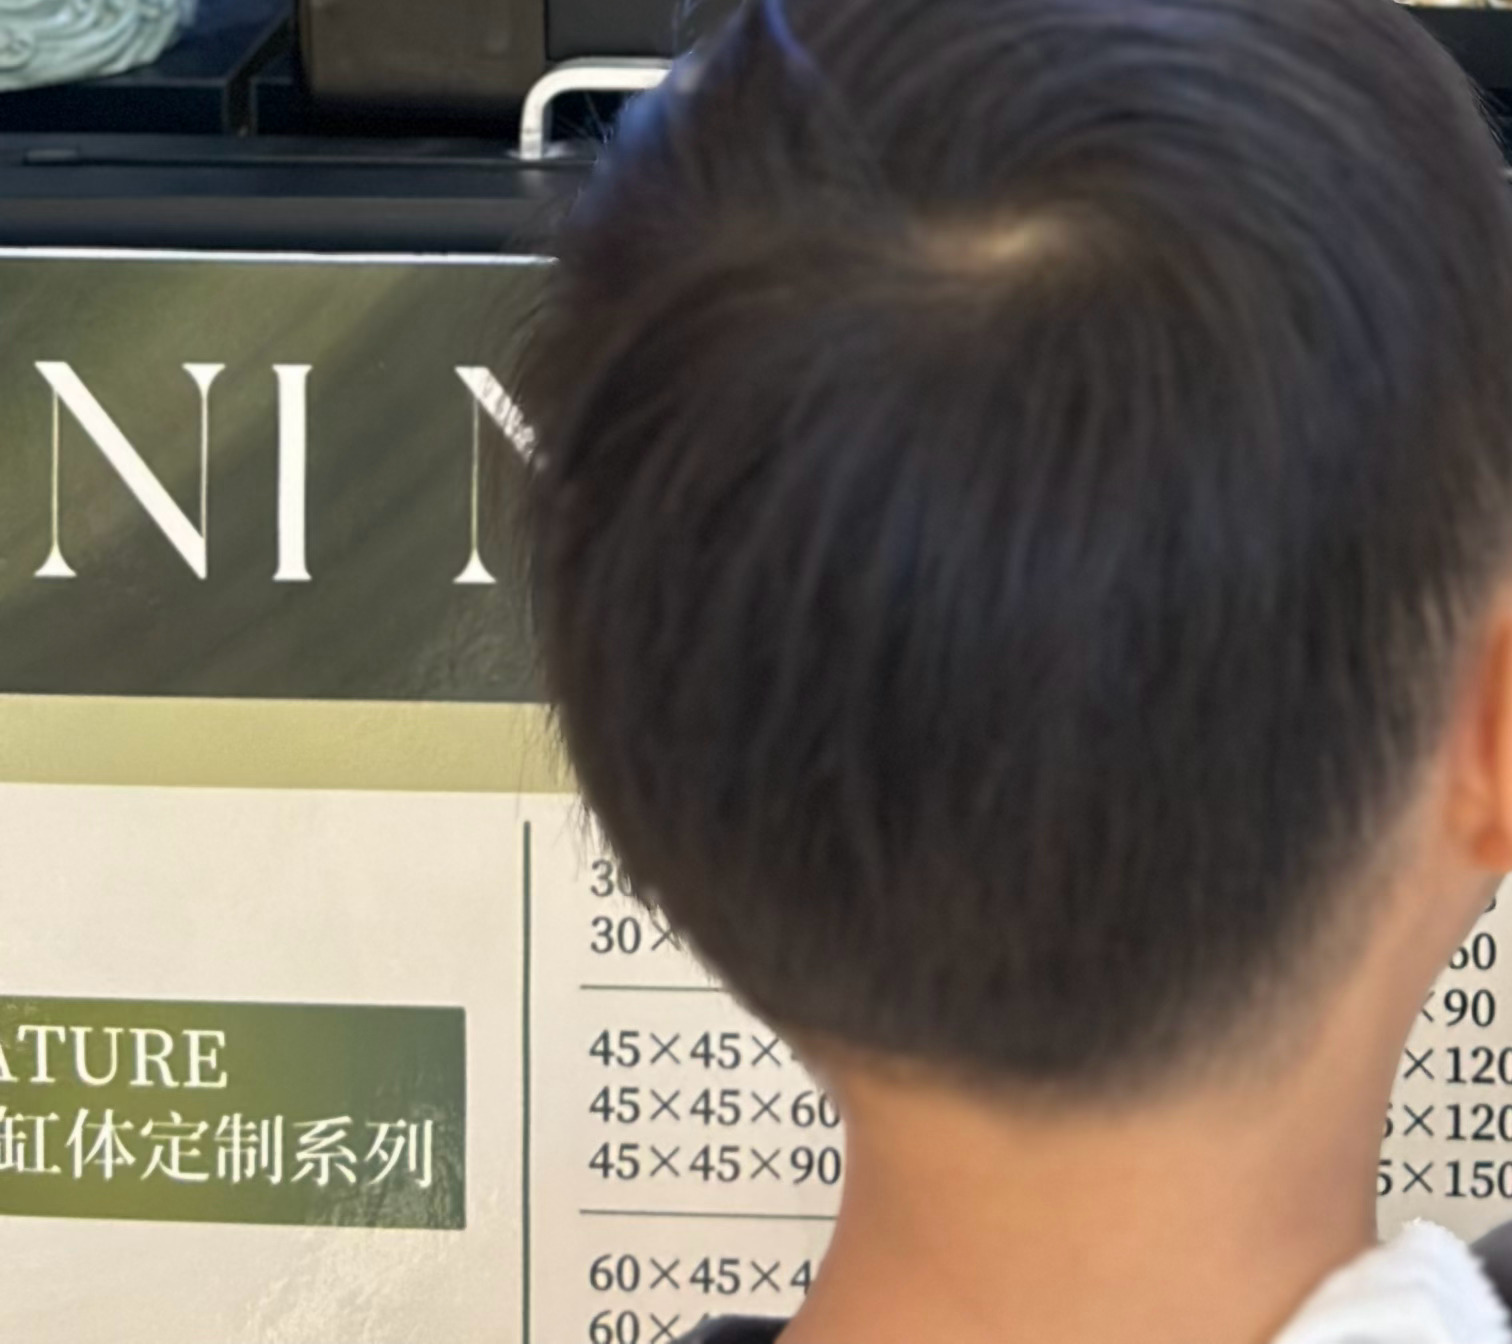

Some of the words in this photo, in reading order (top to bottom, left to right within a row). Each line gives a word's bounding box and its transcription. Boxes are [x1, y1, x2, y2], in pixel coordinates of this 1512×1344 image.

[589, 1085, 842, 1129] 45×45×60
[0, 1107, 436, 1189] 缸体定制系列
[588, 1141, 843, 1186] 45×45×90
